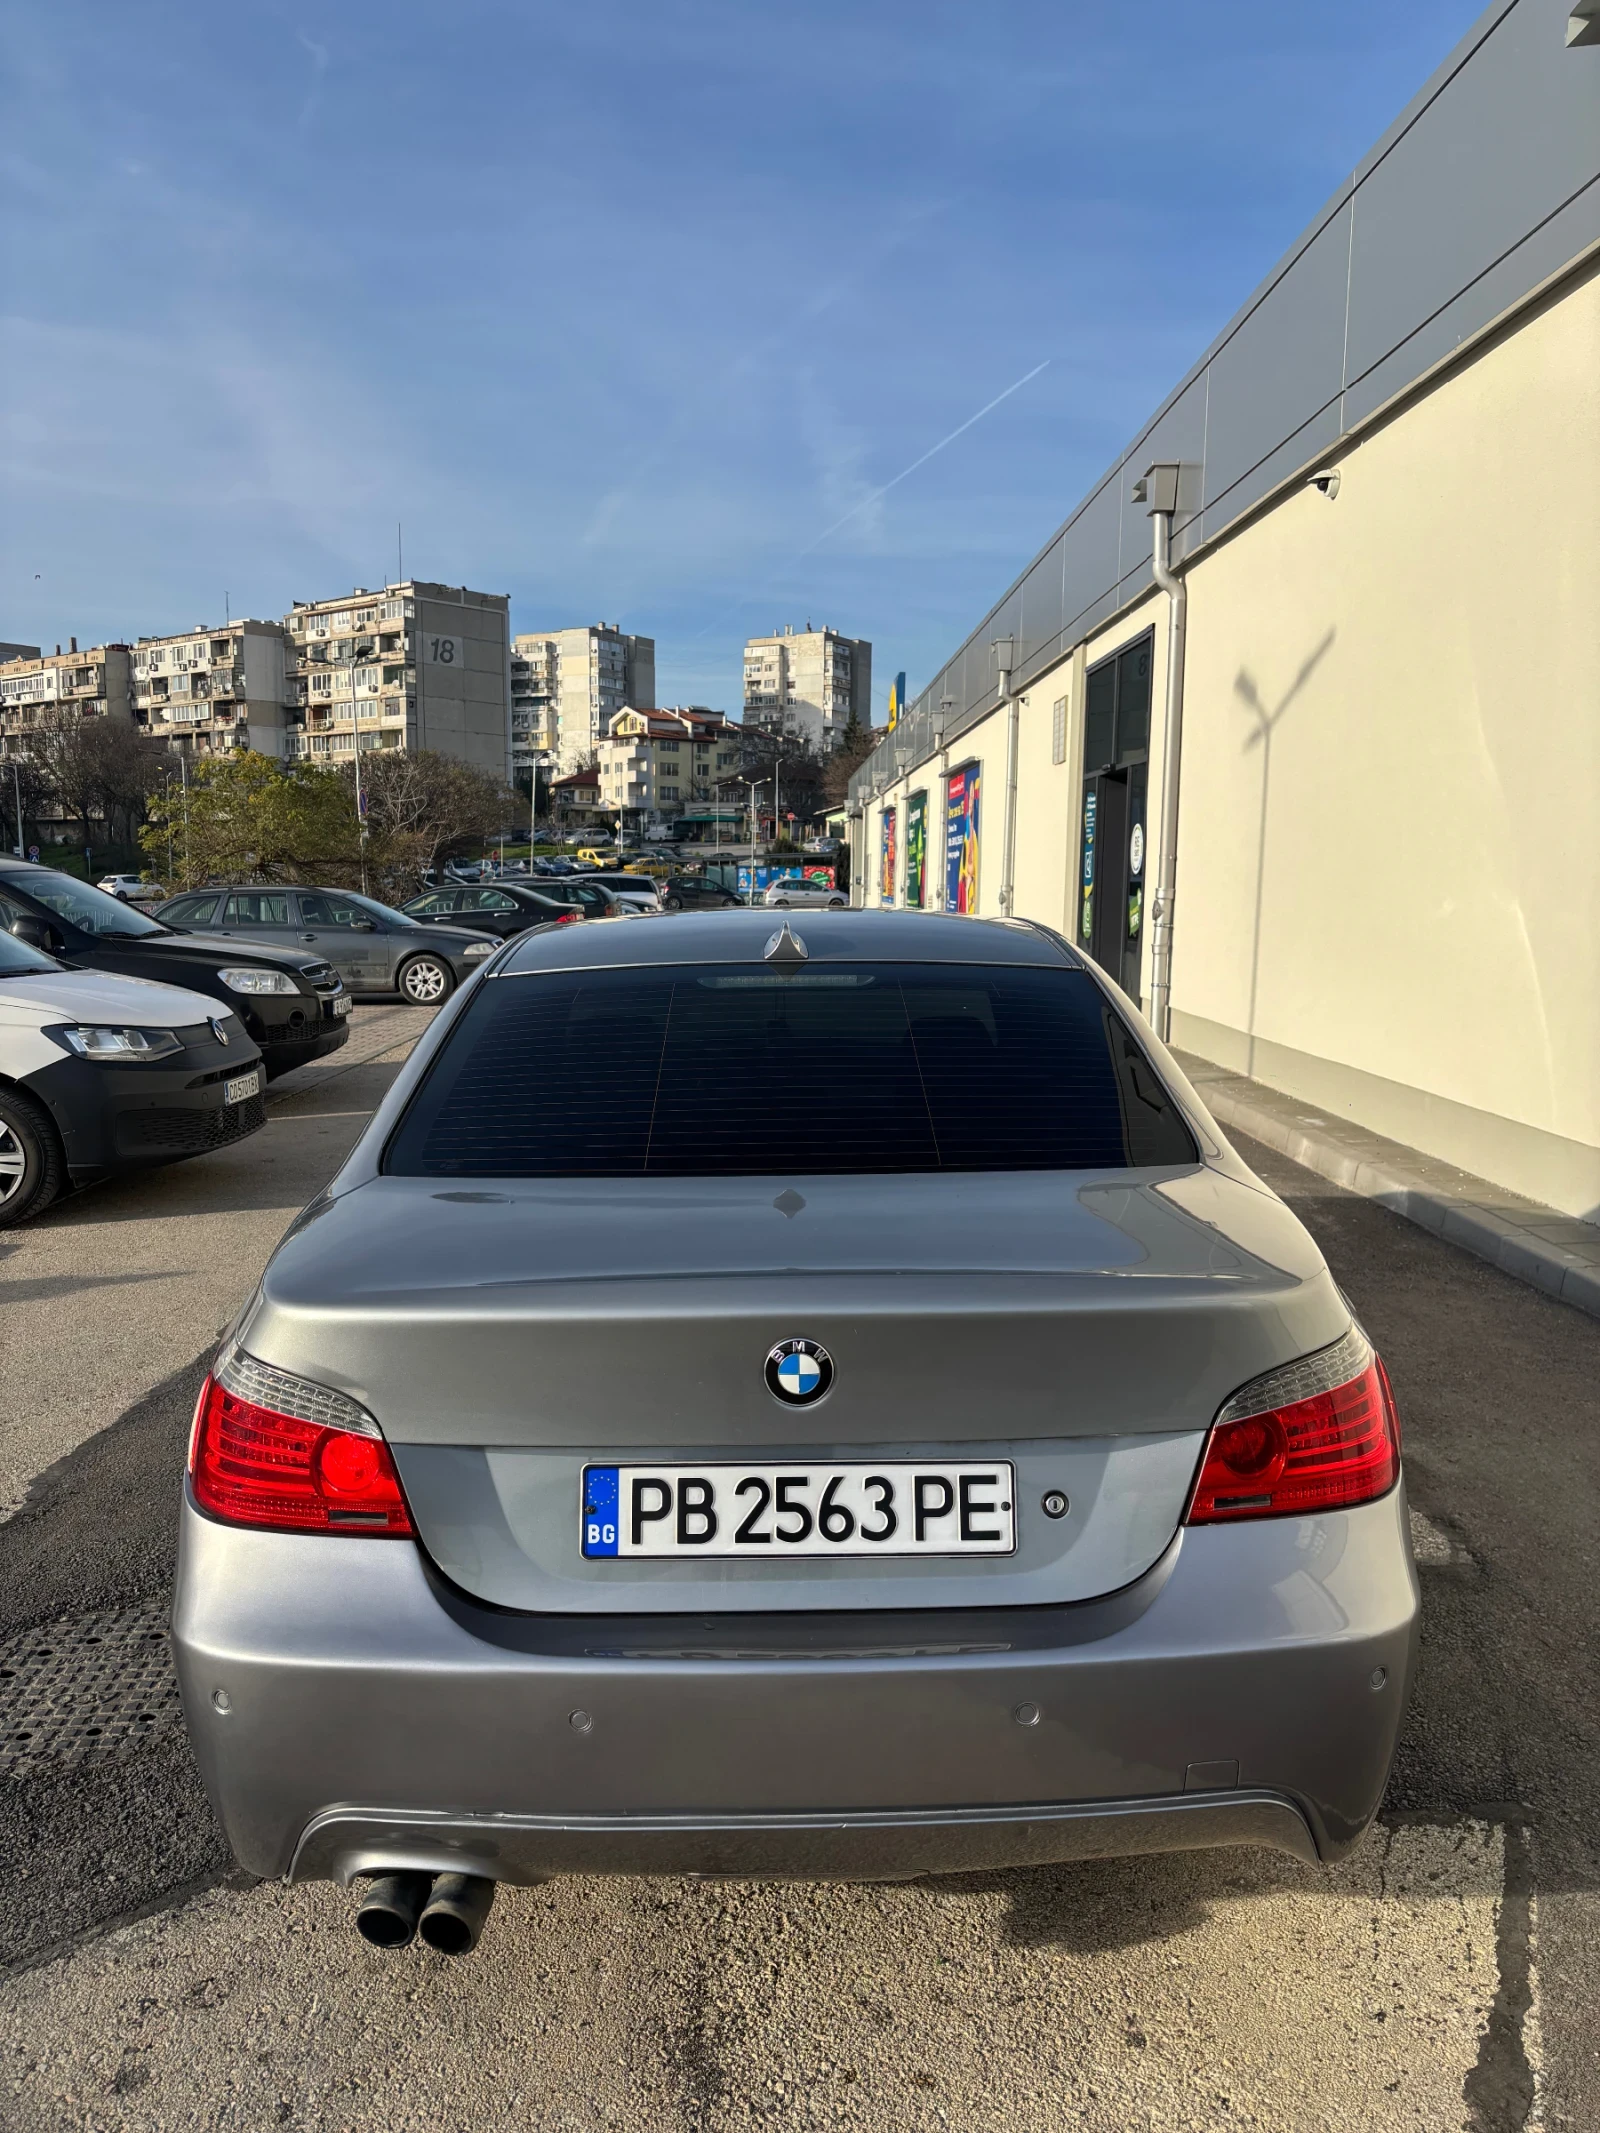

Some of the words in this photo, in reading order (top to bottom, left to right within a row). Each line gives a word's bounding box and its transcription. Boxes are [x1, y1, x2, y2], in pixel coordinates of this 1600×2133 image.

[431, 638, 454, 663] 18
[771, 1341, 828, 1363] BMW
[631, 1477, 719, 1545] PB
[734, 1475, 898, 1544] 2563
[914, 1475, 1001, 1542] PE
[588, 1524, 615, 1544] BG
